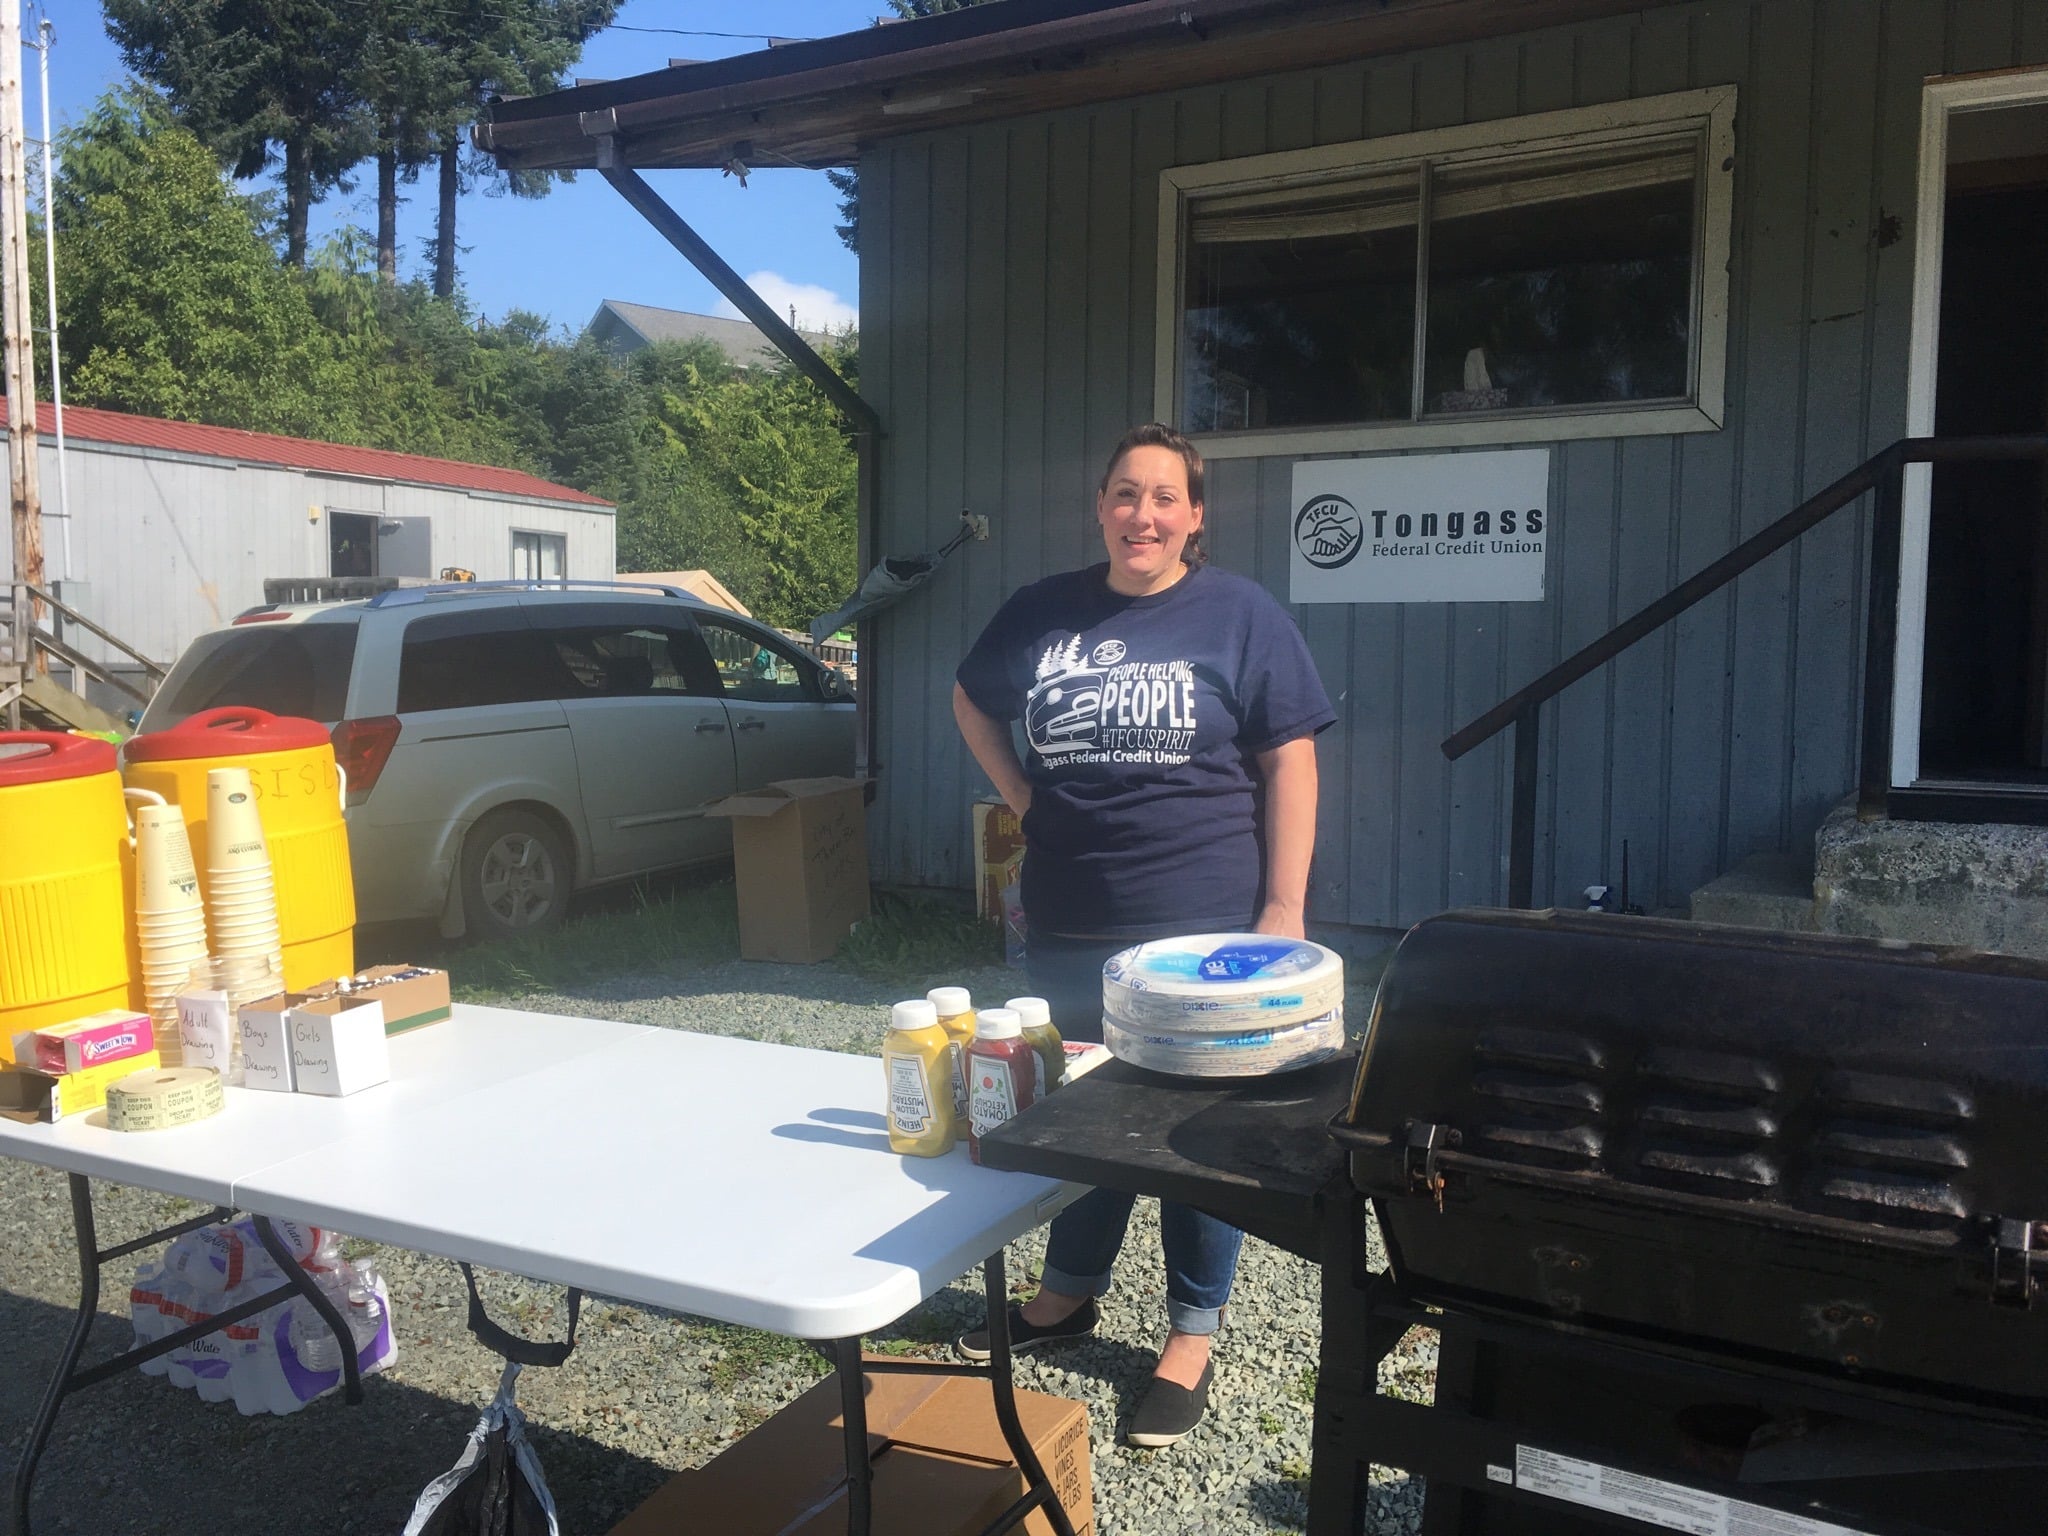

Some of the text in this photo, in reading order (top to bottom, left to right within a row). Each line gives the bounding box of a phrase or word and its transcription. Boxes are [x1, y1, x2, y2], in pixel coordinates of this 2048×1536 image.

[1306, 504, 1339, 523] TFCU
[1371, 509, 1543, 540] Tongass
[1372, 540, 1543, 557] Federal Credit Union
[1107, 660, 1195, 682] PEOPLE HELPING
[1101, 680, 1197, 728] PEOPLE
[1102, 728, 1196, 751] #TFCUSPIRIT
[1069, 750, 1110, 764] Federal
[1112, 749, 1152, 763] Credit
[1154, 750, 1191, 765] Union
[1268, 998, 1281, 1007] 44
[183, 1008, 209, 1029] Adult
[242, 1020, 269, 1047] Boys
[295, 1023, 321, 1043] Girls
[180, 1032, 215, 1059] Drawing
[242, 1054, 278, 1079] Drawing
[295, 1051, 329, 1074] Drawing
[127, 1103, 153, 1112] COUPON
[167, 1096, 194, 1107] COUPON
[891, 1093, 924, 1107] MUSTARD
[895, 1104, 920, 1116] YELLOW
[974, 1098, 1007, 1111] KETCHUP
[974, 1105, 1008, 1121] TOMATO
[896, 1117, 921, 1130] HEINZ
[192, 1340, 221, 1355] Water
[1054, 1417, 1084, 1460] LICORICE
[1055, 1449, 1075, 1481] VINES
[1063, 1467, 1078, 1496] JARS
[1069, 1483, 1082, 1510] LBS
